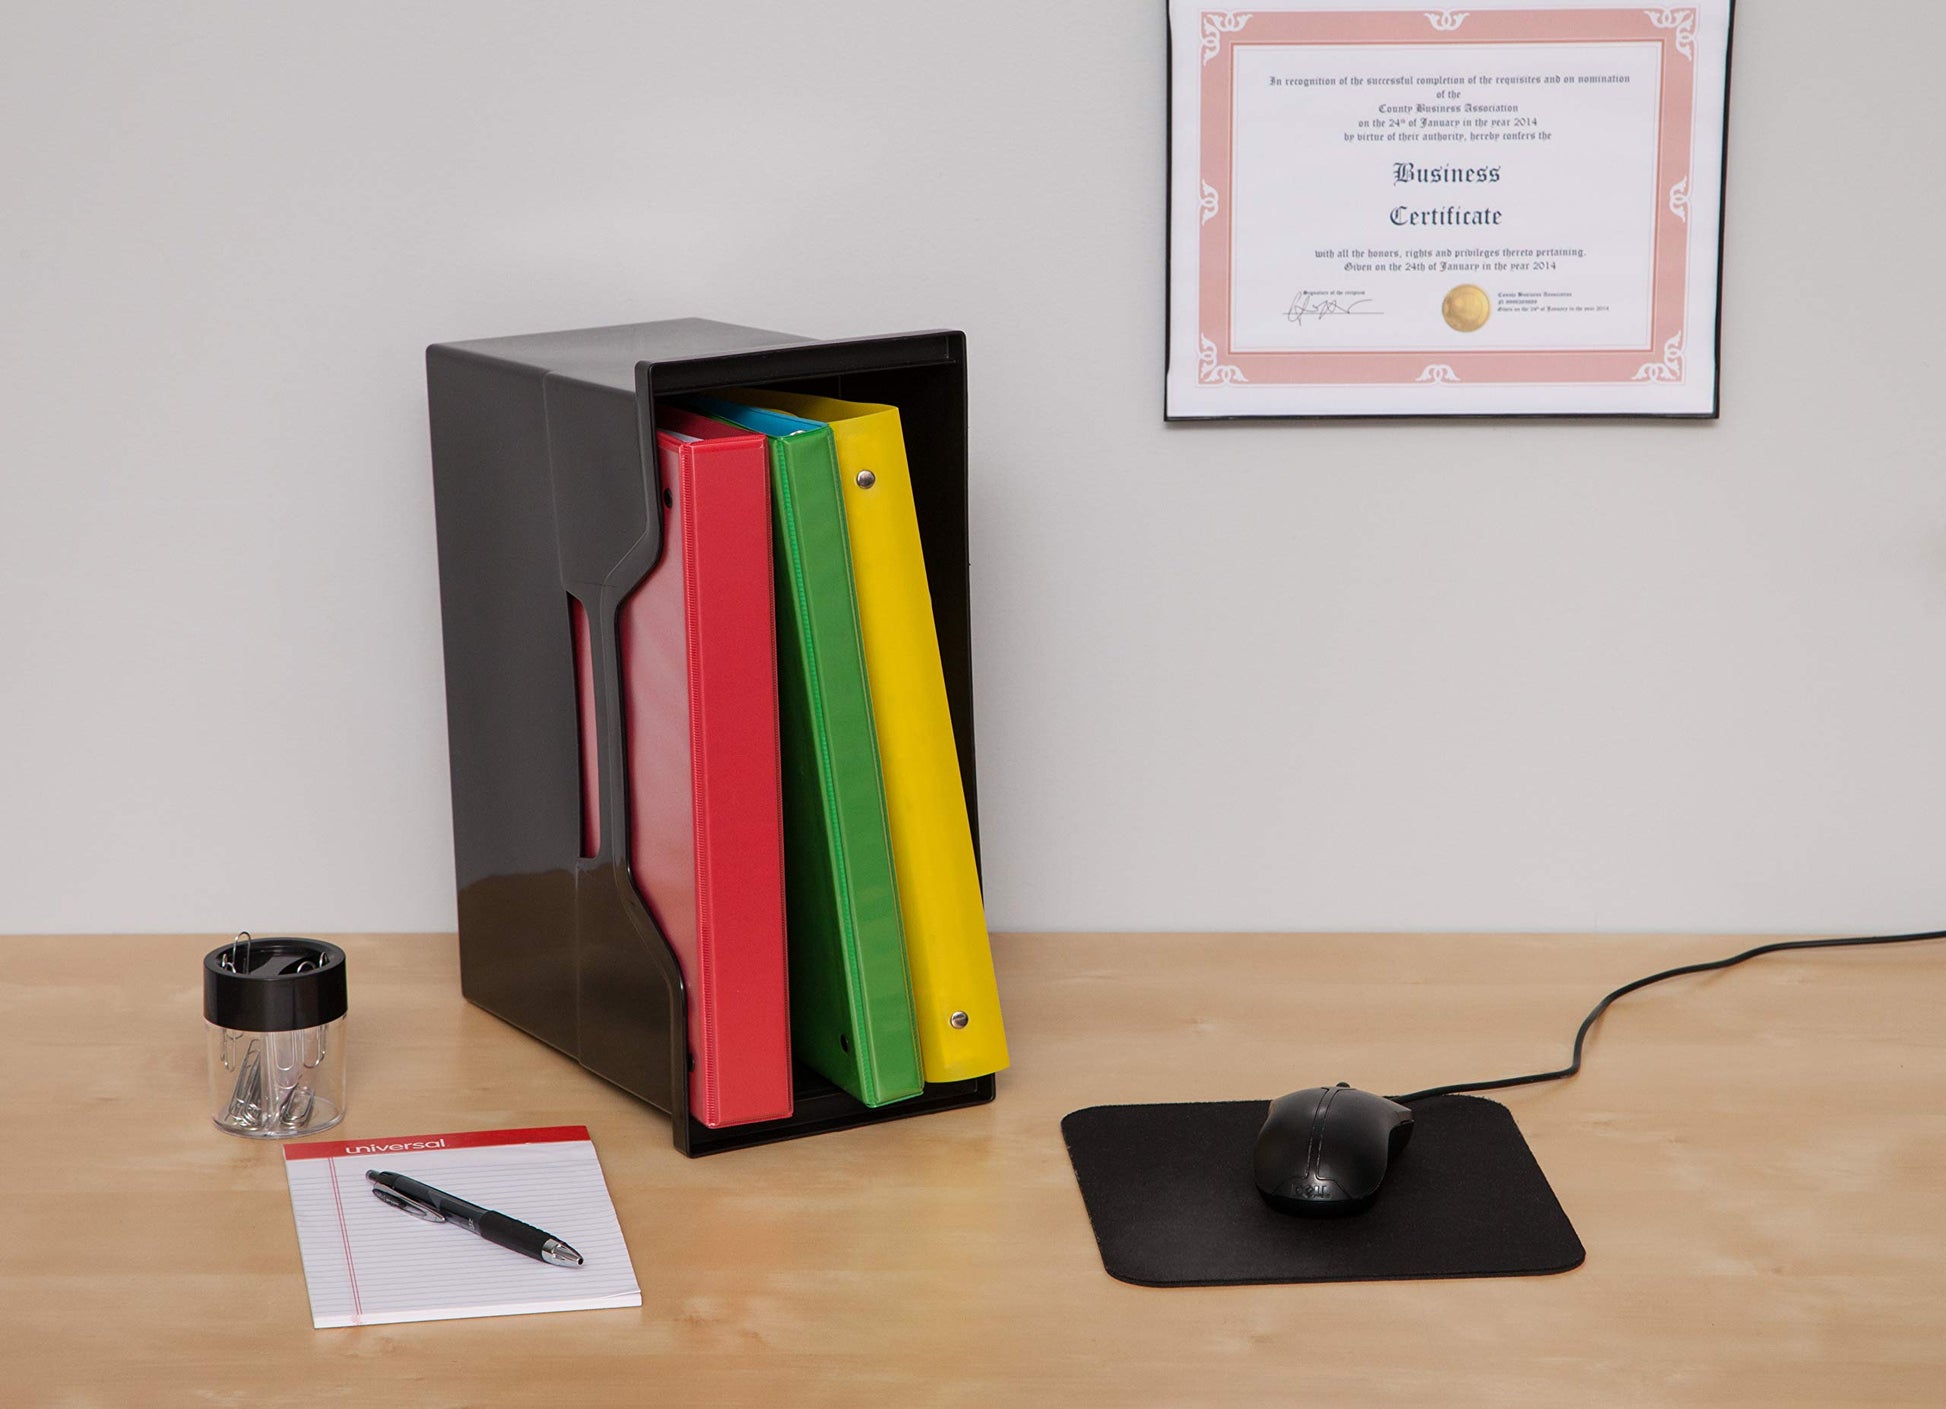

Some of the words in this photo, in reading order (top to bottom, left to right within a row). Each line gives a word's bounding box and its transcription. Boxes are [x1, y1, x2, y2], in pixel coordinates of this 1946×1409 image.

[1269, 76, 1282, 86] In
[1285, 76, 1336, 87] recognition
[1339, 76, 1348, 85] of
[1351, 76, 1364, 86] the
[1367, 76, 1413, 85] successful
[1416, 76, 1464, 86] completion
[1468, 75, 1476, 84] of
[1479, 75, 1493, 85] the
[1496, 75, 1541, 85] requisites
[1544, 75, 1560, 84] and
[1563, 76, 1574, 84] on
[1578, 75, 1630, 84] nomination
[1436, 90, 1445, 99] of
[1448, 90, 1461, 99] the
[1378, 104, 1413, 114] County
[1416, 104, 1461, 113] Business
[1464, 103, 1518, 112] Association
[1373, 119, 1385, 128] the
[1408, 118, 1417, 127] of
[1420, 117, 1460, 129] January
[1463, 119, 1471, 127] in
[1475, 118, 1488, 128] the
[1491, 119, 1510, 128] year
[1513, 117, 1537, 127] 2014
[1344, 132, 1354, 142] by
[1357, 132, 1384, 141] virtue
[1387, 132, 1395, 141] of
[1399, 132, 1419, 142] their
[1422, 132, 1467, 142] authority,
[1470, 132, 1500, 141] hereby
[1503, 131, 1535, 140] confers
[1539, 131, 1552, 141] the
[1393, 162, 1501, 186] Business
[1390, 206, 1502, 226] Certificate
[1315, 249, 1334, 258] with
[1337, 249, 1349, 258] all
[1352, 249, 1365, 258] the
[1368, 249, 1402, 259] honors,
[1405, 248, 1433, 259] rights
[1436, 248, 1452, 257] and
[1455, 248, 1500, 259] privileges
[1502, 248, 1533, 258] thereto
[1536, 248, 1586, 258] pertaining.
[1344, 262, 1372, 271] Given
[1375, 263, 1386, 271] on
[1389, 262, 1402, 272] the
[1405, 262, 1425, 271] 24th
[1428, 262, 1437, 271] of
[1440, 261, 1479, 272] January
[1482, 263, 1491, 271] in
[1494, 262, 1507, 271] the
[1510, 263, 1529, 272] year
[1532, 261, 1556, 270] 2014
[345, 1138, 446, 1154] universal
